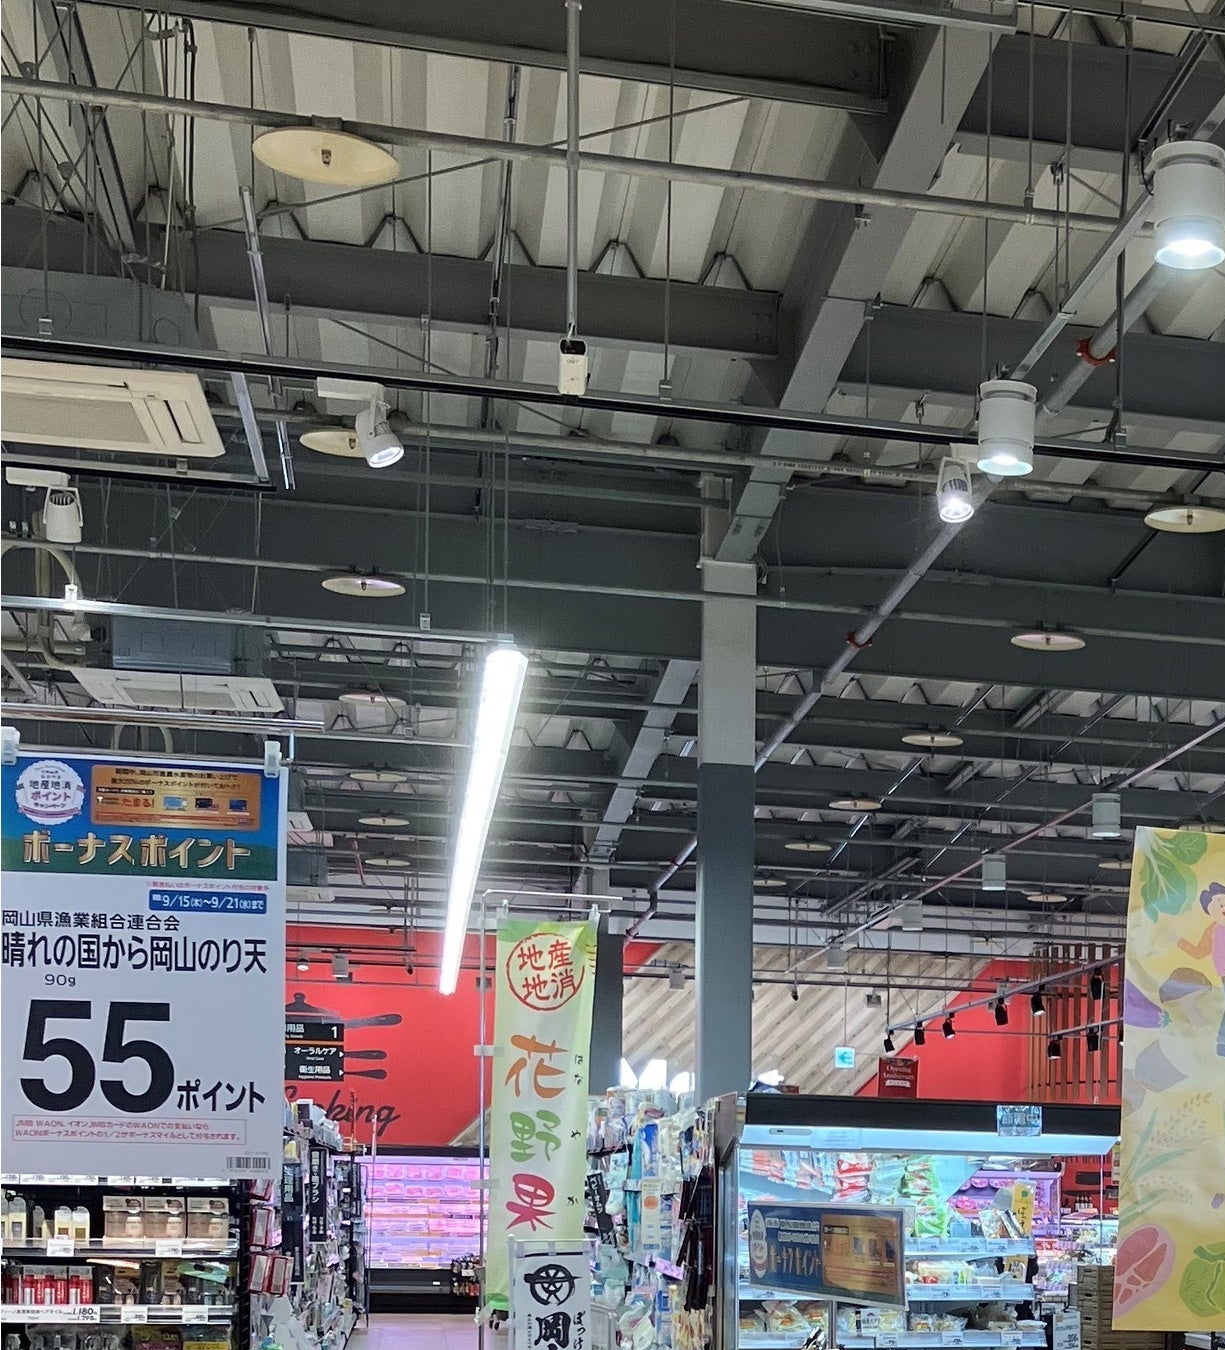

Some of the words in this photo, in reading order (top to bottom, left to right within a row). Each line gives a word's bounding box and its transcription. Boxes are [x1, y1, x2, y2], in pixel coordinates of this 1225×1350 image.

[29, 780, 72, 791] 地産地消
[31, 791, 72, 801] ポイント
[23, 830, 251, 871] ボーナスポイント
[2, 910, 180, 932] 岡山県漁業組合連合会
[1, 931, 268, 974] 晴れの国から岡山のり天
[518, 939, 574, 970] 地産
[44, 973, 76, 987] 90g
[521, 970, 576, 1001] 地消
[20, 998, 176, 1114] 55
[293, 1046, 337, 1056] オーラルケア
[177, 1080, 267, 1113] ポイント
[504, 1033, 569, 1232] 花野果
